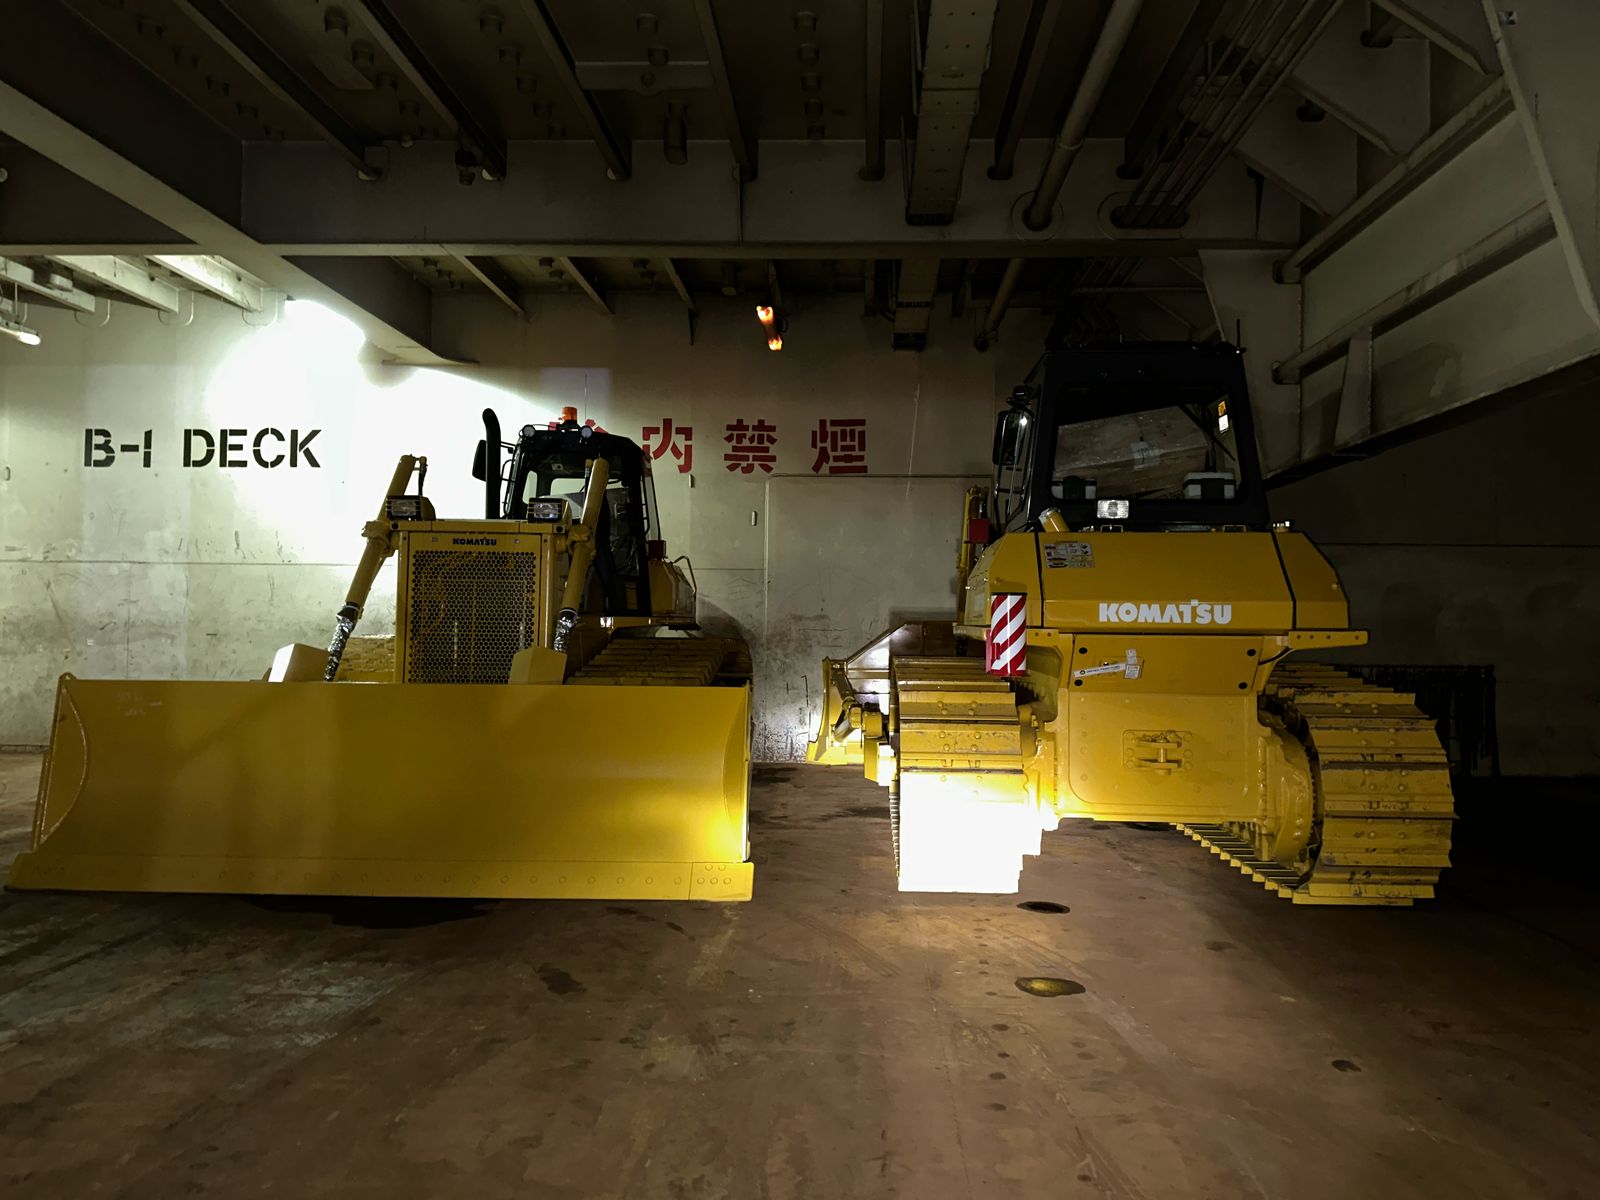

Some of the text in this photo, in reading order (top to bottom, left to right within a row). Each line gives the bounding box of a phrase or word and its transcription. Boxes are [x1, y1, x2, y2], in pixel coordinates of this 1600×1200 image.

[183, 427, 322, 468] DECK
[548, 418, 868, 475] 内禁煙
[453, 537, 497, 546] KOMATSU
[1099, 599, 1232, 624] KOMATSU
